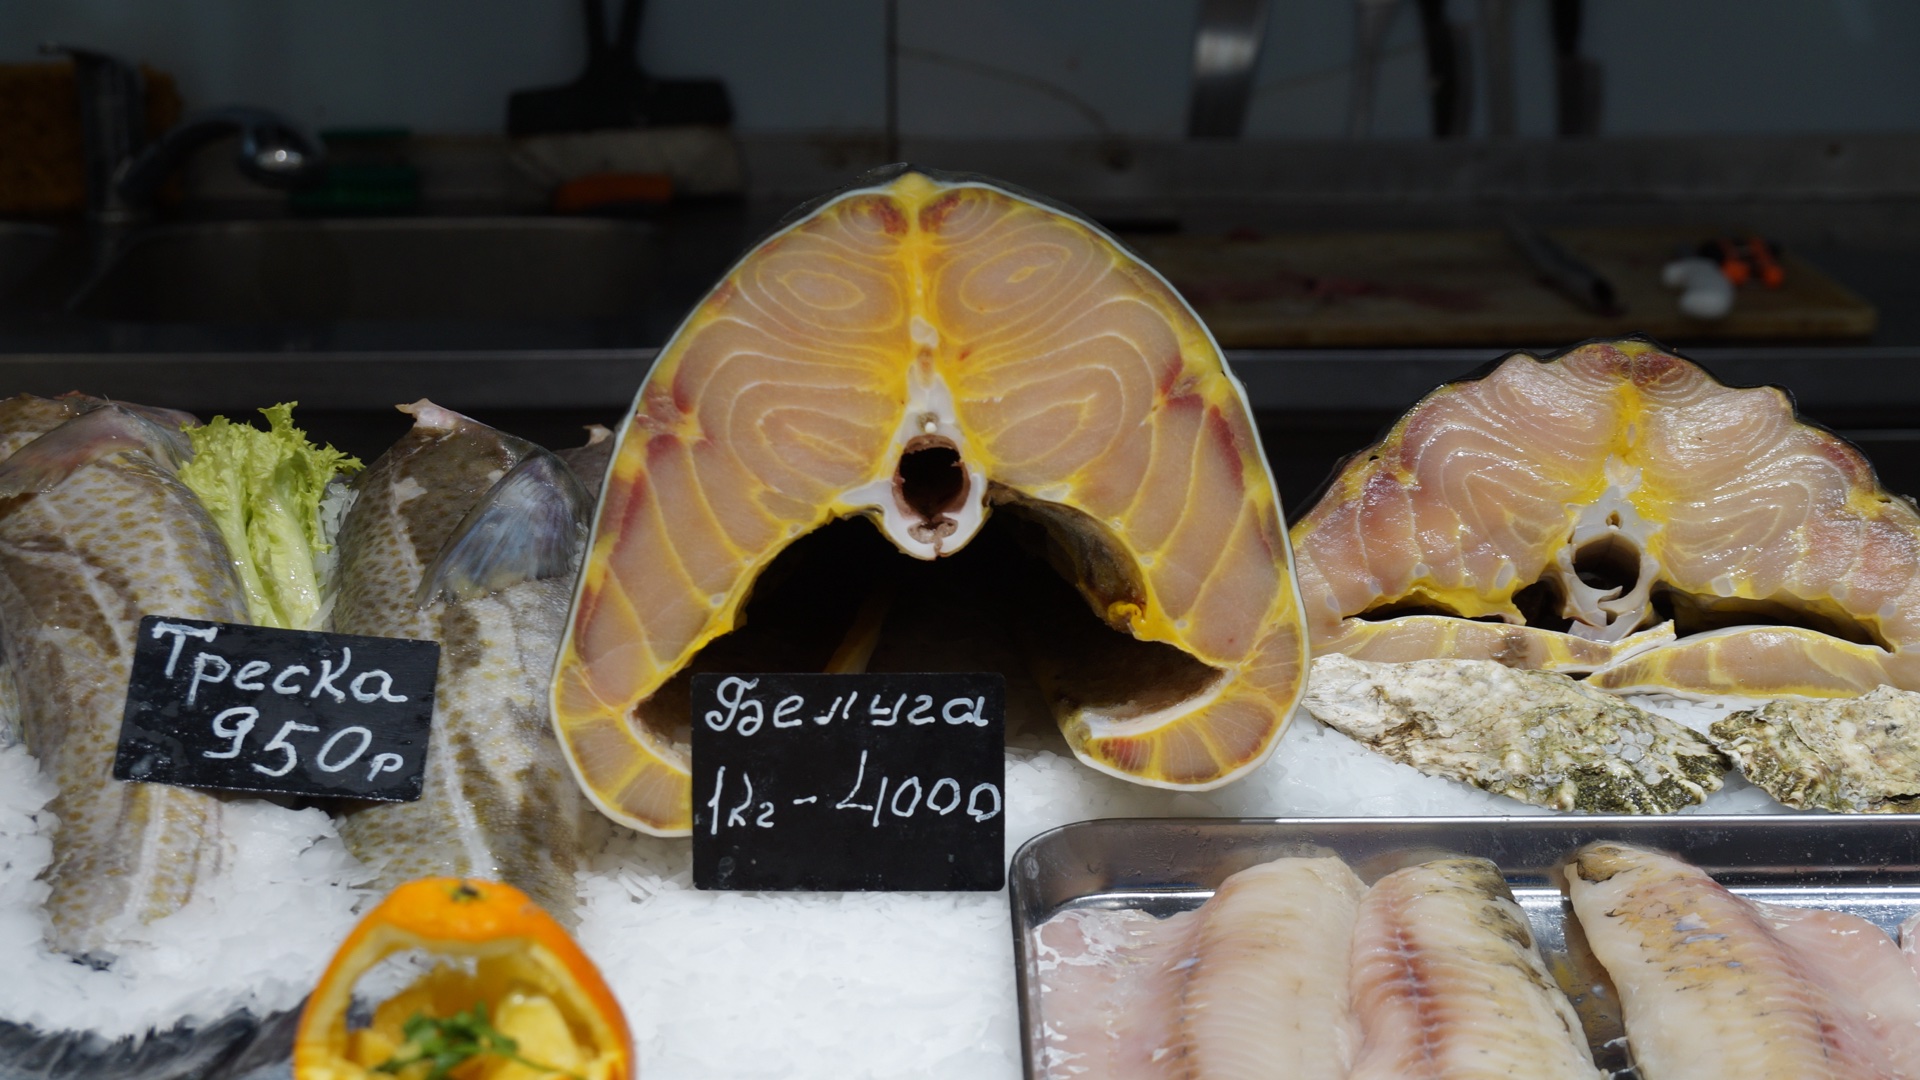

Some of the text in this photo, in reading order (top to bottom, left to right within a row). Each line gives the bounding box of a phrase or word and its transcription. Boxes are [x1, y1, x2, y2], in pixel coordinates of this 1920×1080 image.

[151, 620, 409, 706] Треска
[202, 706, 404, 782] 950р
[705, 676, 989, 737] Белуга
[835, 750, 1002, 828] 4000
